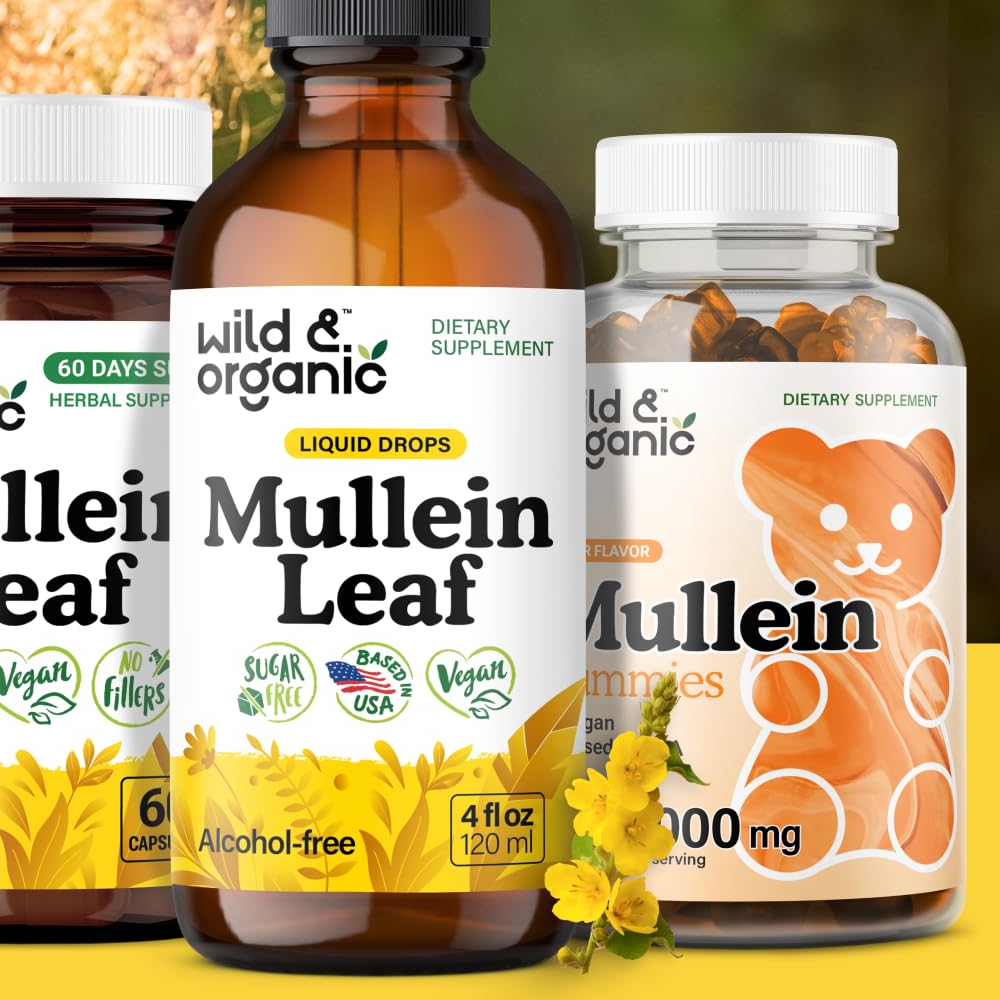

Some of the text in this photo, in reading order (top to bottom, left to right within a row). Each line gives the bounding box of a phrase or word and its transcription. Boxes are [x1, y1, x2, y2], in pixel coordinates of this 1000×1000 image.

[198, 308, 291, 354] wild
[431, 319, 511, 335] DIETARY
[431, 340, 554, 357] SUPPLEMENT
[57, 359, 170, 377] 60 DAYS S
[197, 344, 387, 412] organic
[49, 392, 122, 408] HERBAL
[783, 392, 938, 408] DIETARY SUPPLEMENT
[299, 436, 452, 454] LIQUID DROPS
[204, 475, 554, 549] Mullein
[594, 545, 650, 558] FLAVOR
[276, 553, 484, 627] Leaf
[118, 650, 143, 675] NO
[244, 653, 305, 684] SUGAR
[356, 649, 413, 697] BASED IN
[436, 659, 508, 697] Vegan
[586, 661, 724, 699] mmes
[265, 684, 303, 716] FREE
[353, 694, 394, 716] USA
[139, 787, 171, 828] 6
[460, 804, 478, 828] 4
[128, 835, 171, 852] CAPS
[198, 828, 356, 856] Alcohol-free
[460, 829, 534, 856] 120 ml
[750, 825, 801, 856] mg
